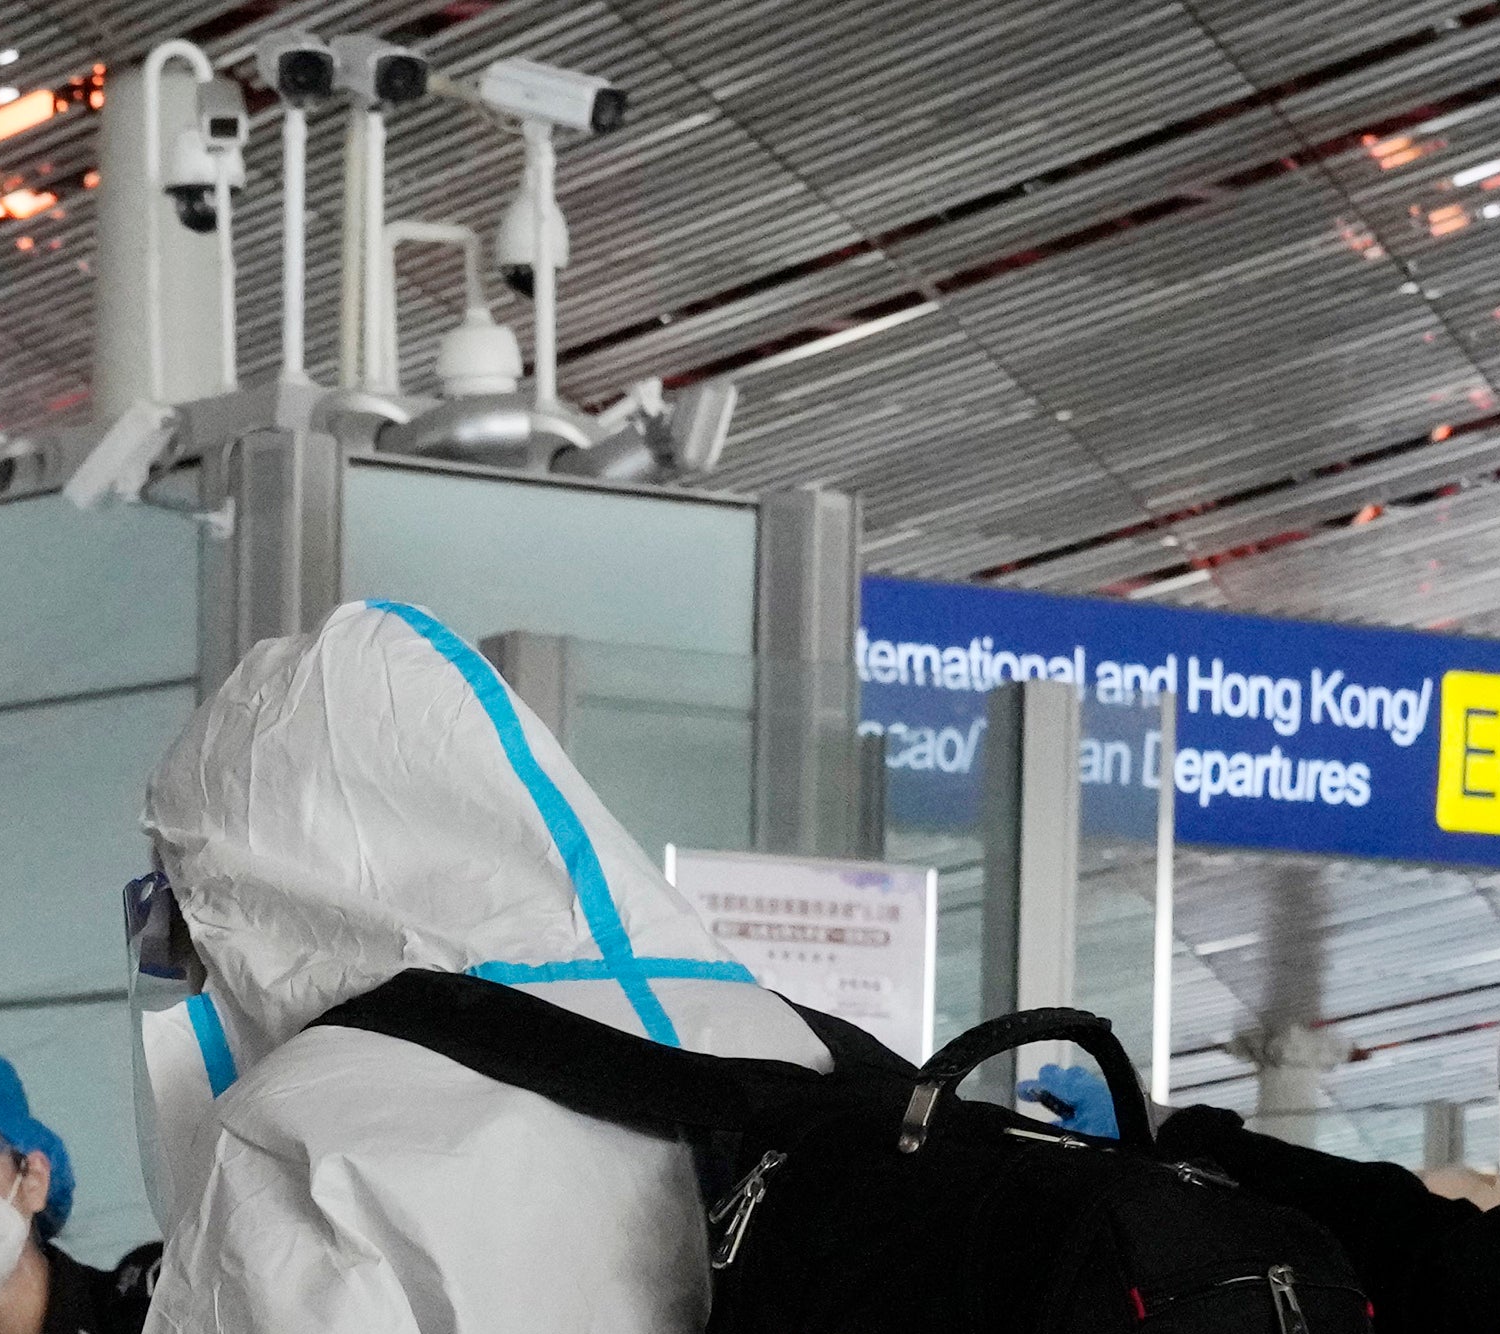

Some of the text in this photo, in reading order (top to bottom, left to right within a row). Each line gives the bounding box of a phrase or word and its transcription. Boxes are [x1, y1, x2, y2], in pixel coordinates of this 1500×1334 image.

[1096, 653, 1178, 708] and
[1187, 656, 1300, 736] Hong
[1310, 667, 1433, 747] Kong/
